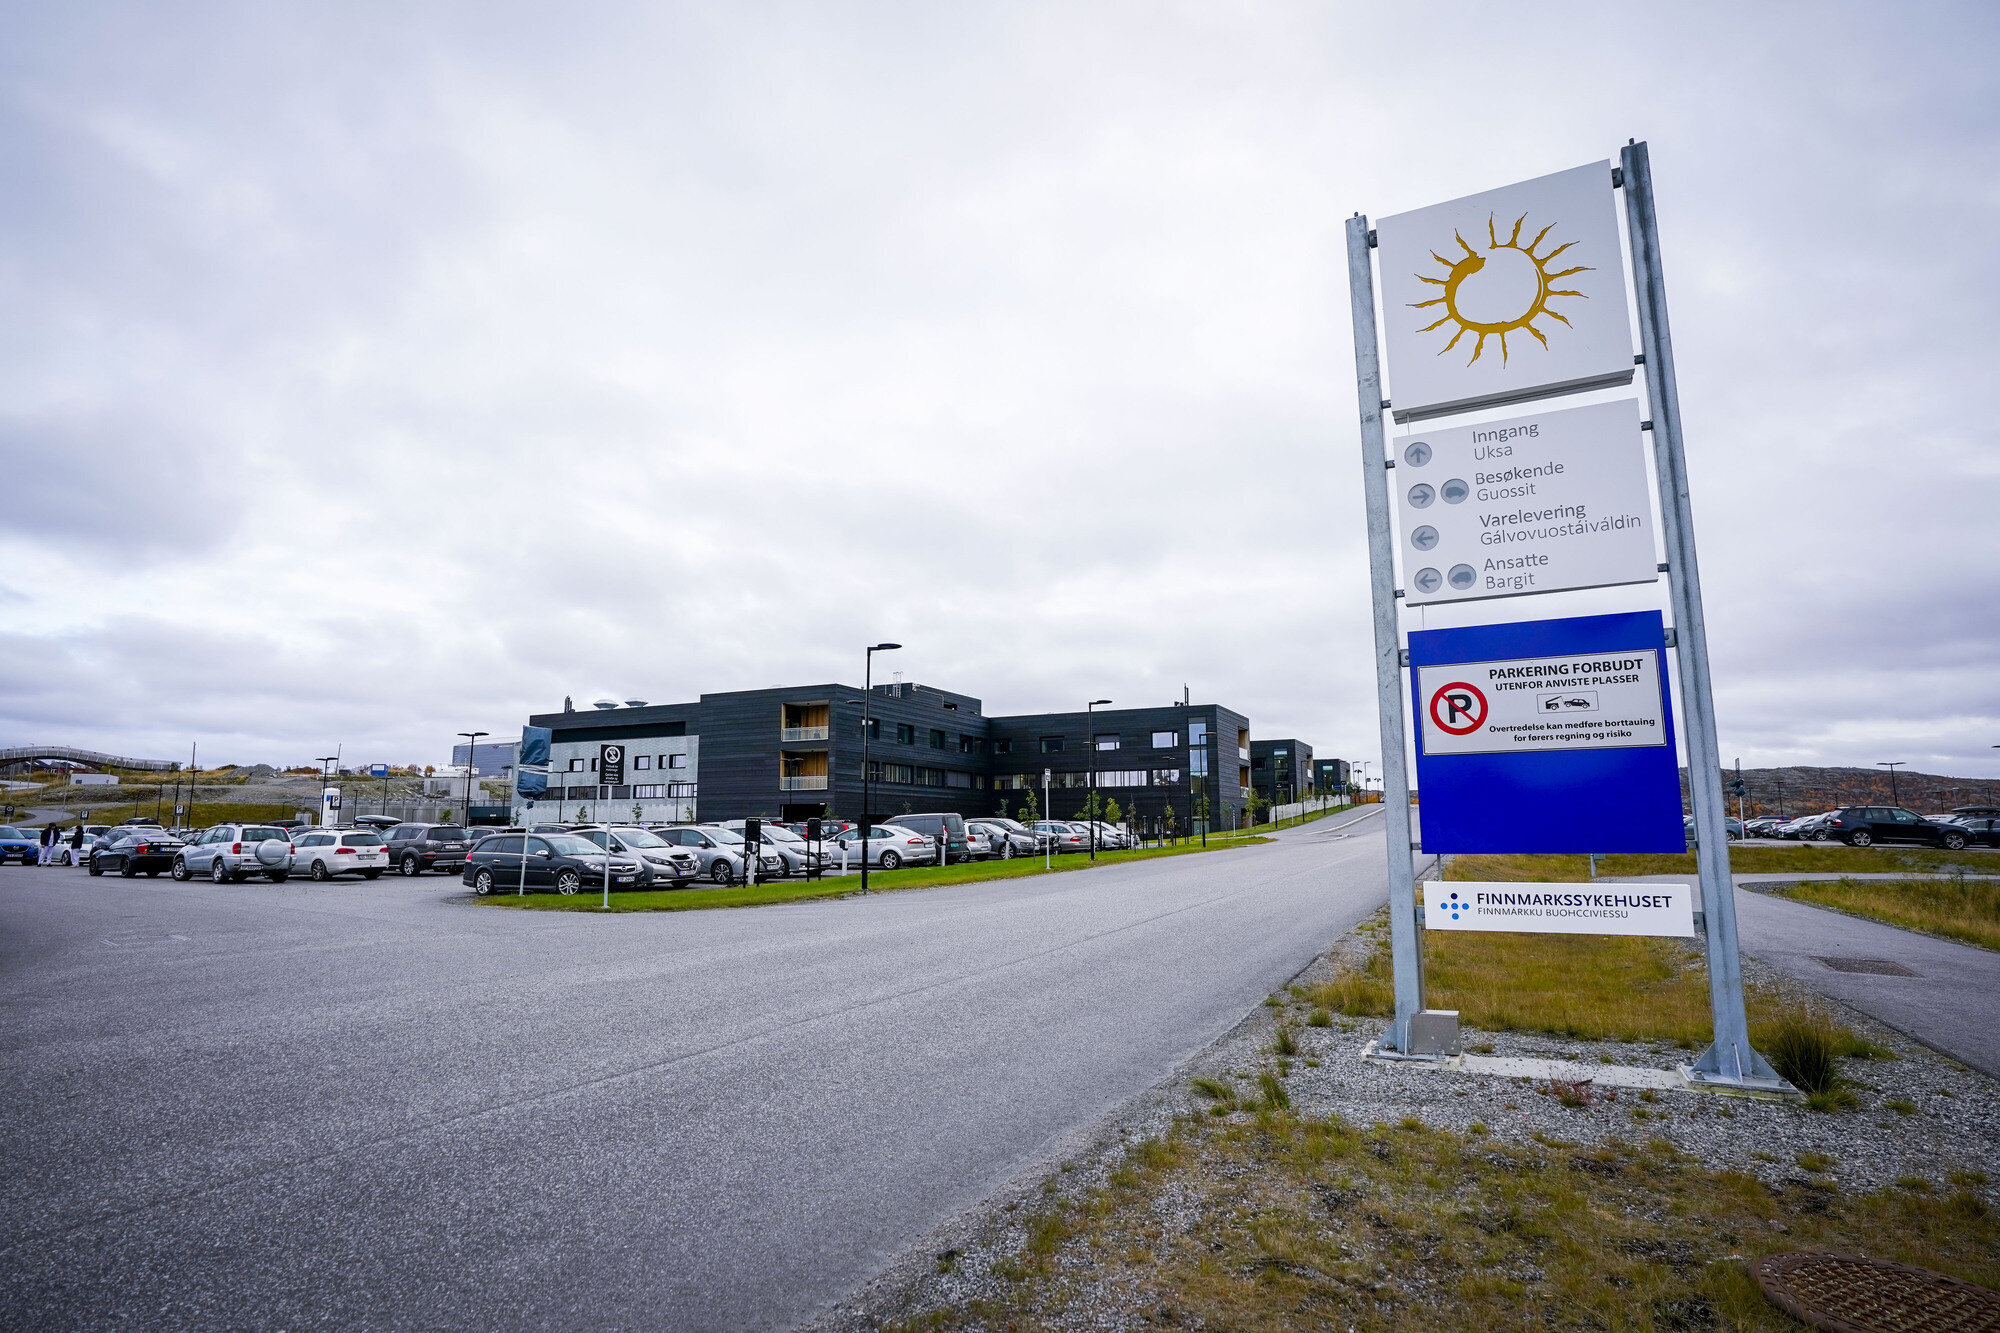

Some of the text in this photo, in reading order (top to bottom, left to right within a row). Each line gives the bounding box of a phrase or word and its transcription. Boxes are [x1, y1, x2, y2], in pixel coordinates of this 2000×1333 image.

[1472, 423, 1539, 444] Inngang
[1474, 444, 1513, 460] Uksa
[1475, 461, 1564, 485] Besøkende
[1477, 483, 1536, 501] Guossit
[1480, 504, 1586, 528] Varelevering
[1480, 514, 1641, 546] Gálvovuostáiváldin
[1484, 553, 1549, 571] Ansatte
[1486, 572, 1535, 590] Bargit
[1489, 659, 1643, 680] PARKERING FORBUDT
[1496, 674, 1639, 691] UTENFOR ANVISTE PLASSER
[1489, 717, 1655, 733] Overtredelse kan medføre borttauing
[1514, 730, 1632, 742] for førers regning og risiko
[1477, 892, 1672, 908] FINNMARKSSYKEHUSET
[1478, 906, 1629, 919] FINNMÁRKKU BUOHCCIVIESSU
